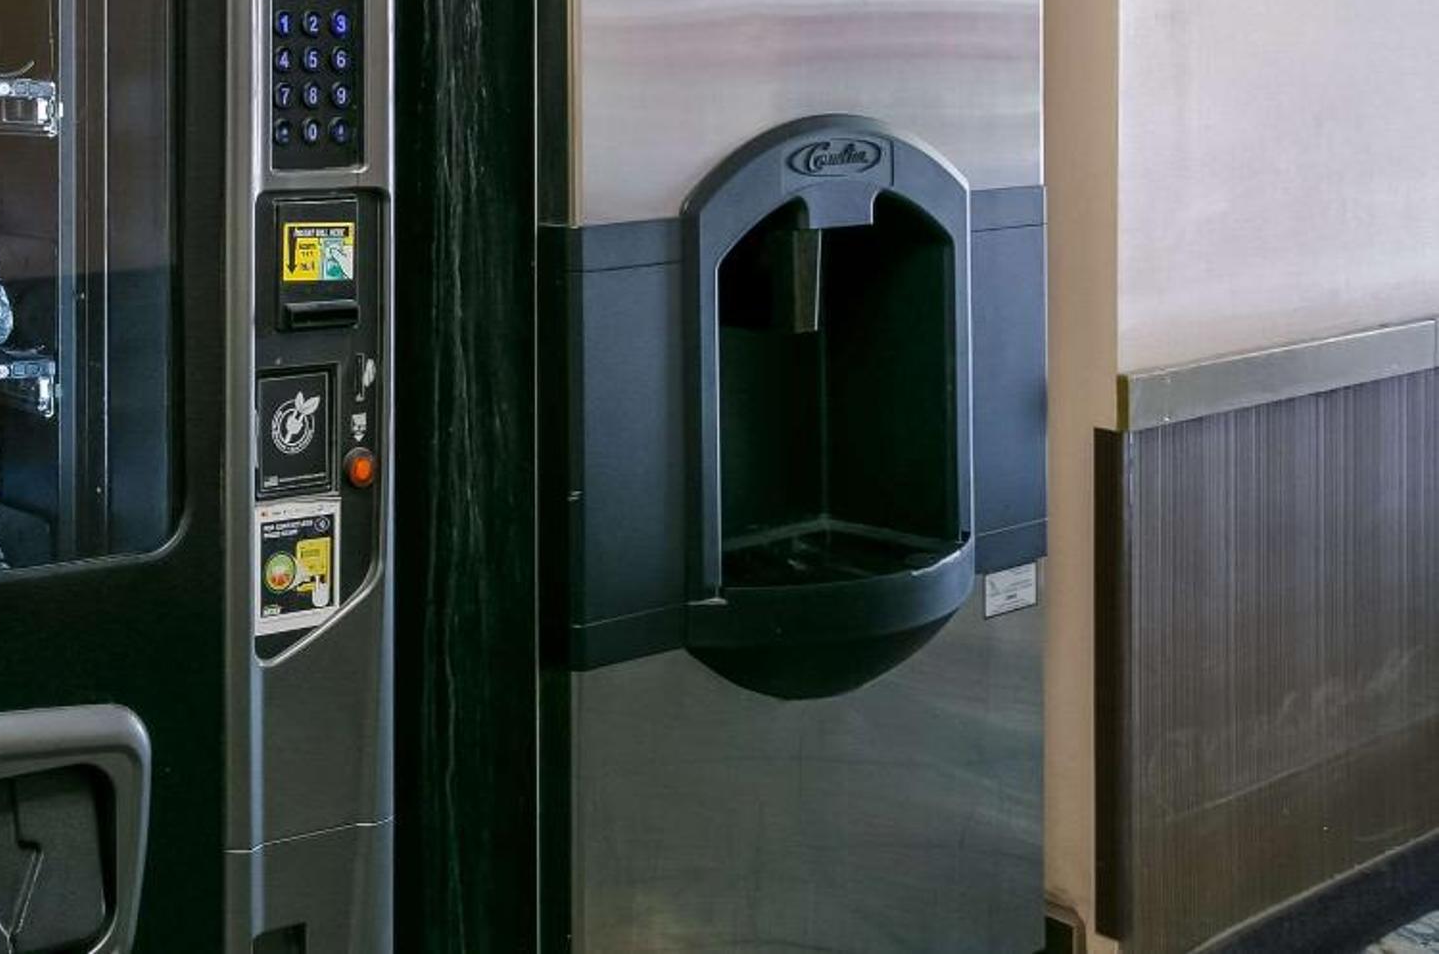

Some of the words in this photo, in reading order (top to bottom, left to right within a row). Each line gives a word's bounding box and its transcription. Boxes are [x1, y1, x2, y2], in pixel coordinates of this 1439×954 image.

[280, 14, 289, 33] 1
[309, 15, 319, 32] 2
[336, 14, 347, 32] 3
[279, 51, 290, 69] 4
[309, 51, 318, 68] 5
[336, 50, 347, 68] 6
[280, 87, 290, 106] 7
[309, 87, 318, 105] 8
[336, 87, 346, 105] 9
[309, 123, 318, 142] 0
